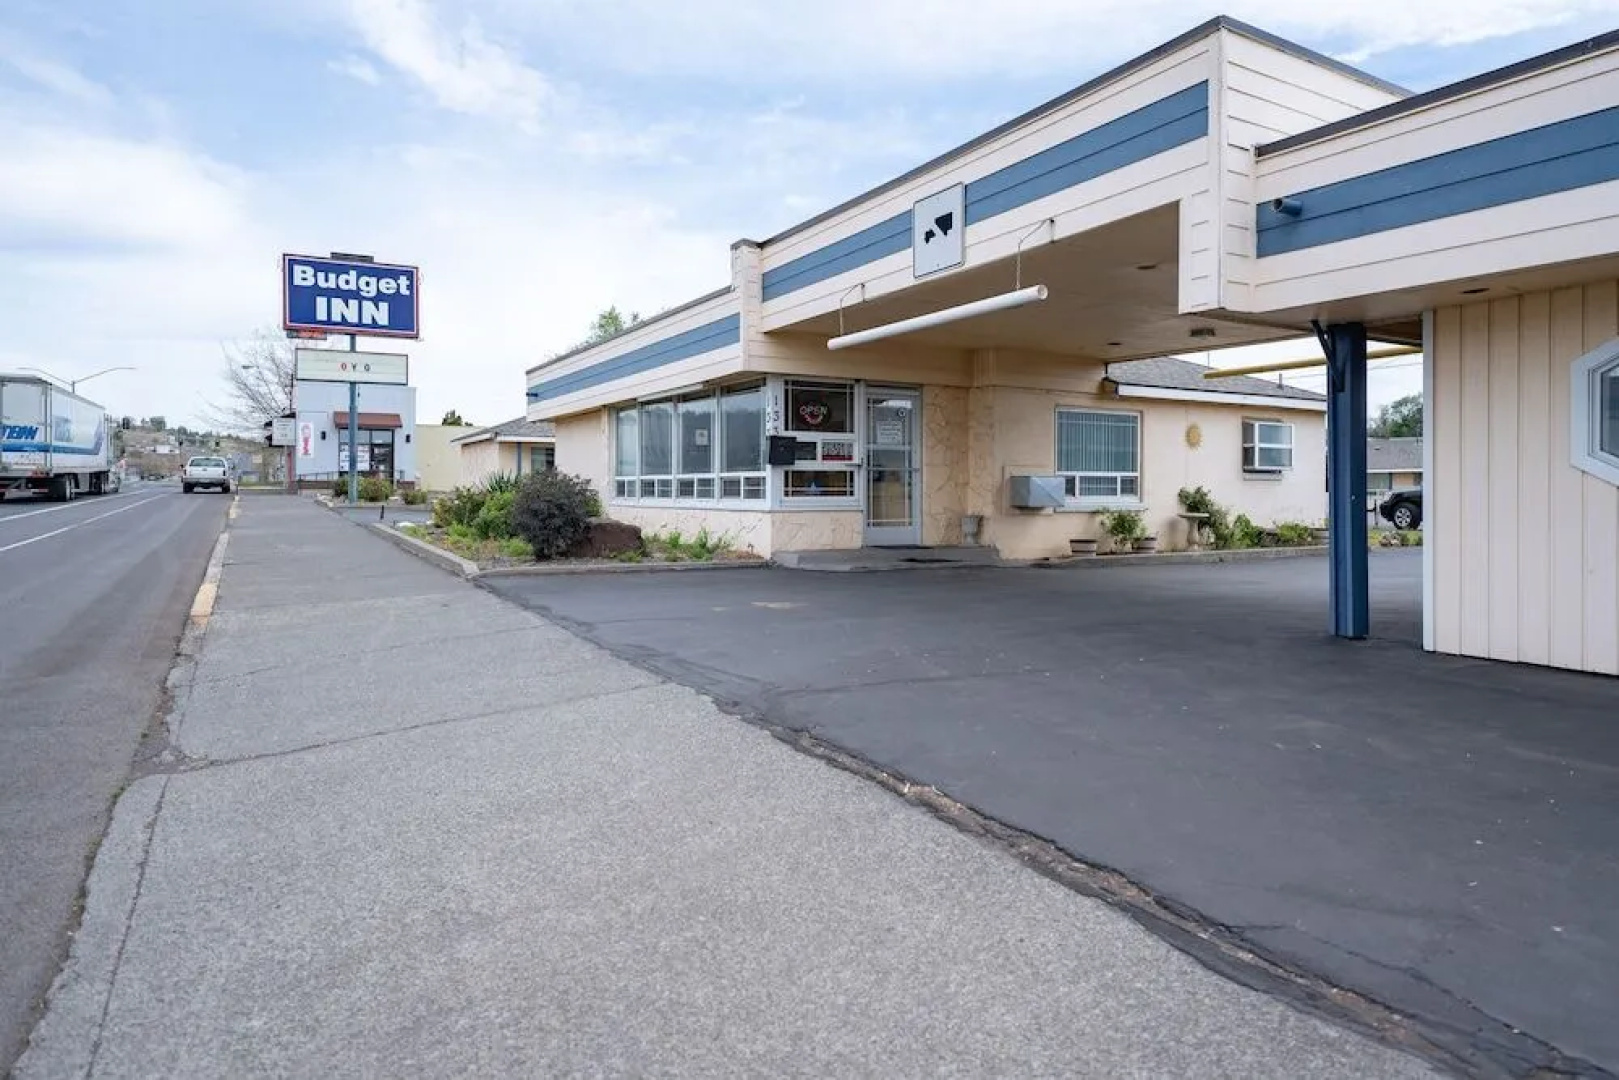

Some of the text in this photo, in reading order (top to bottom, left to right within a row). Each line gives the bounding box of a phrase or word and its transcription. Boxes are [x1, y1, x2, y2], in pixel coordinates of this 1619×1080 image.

[292, 263, 411, 298] Budget
[315, 295, 390, 326] INN
[799, 404, 828, 416] OPEN
